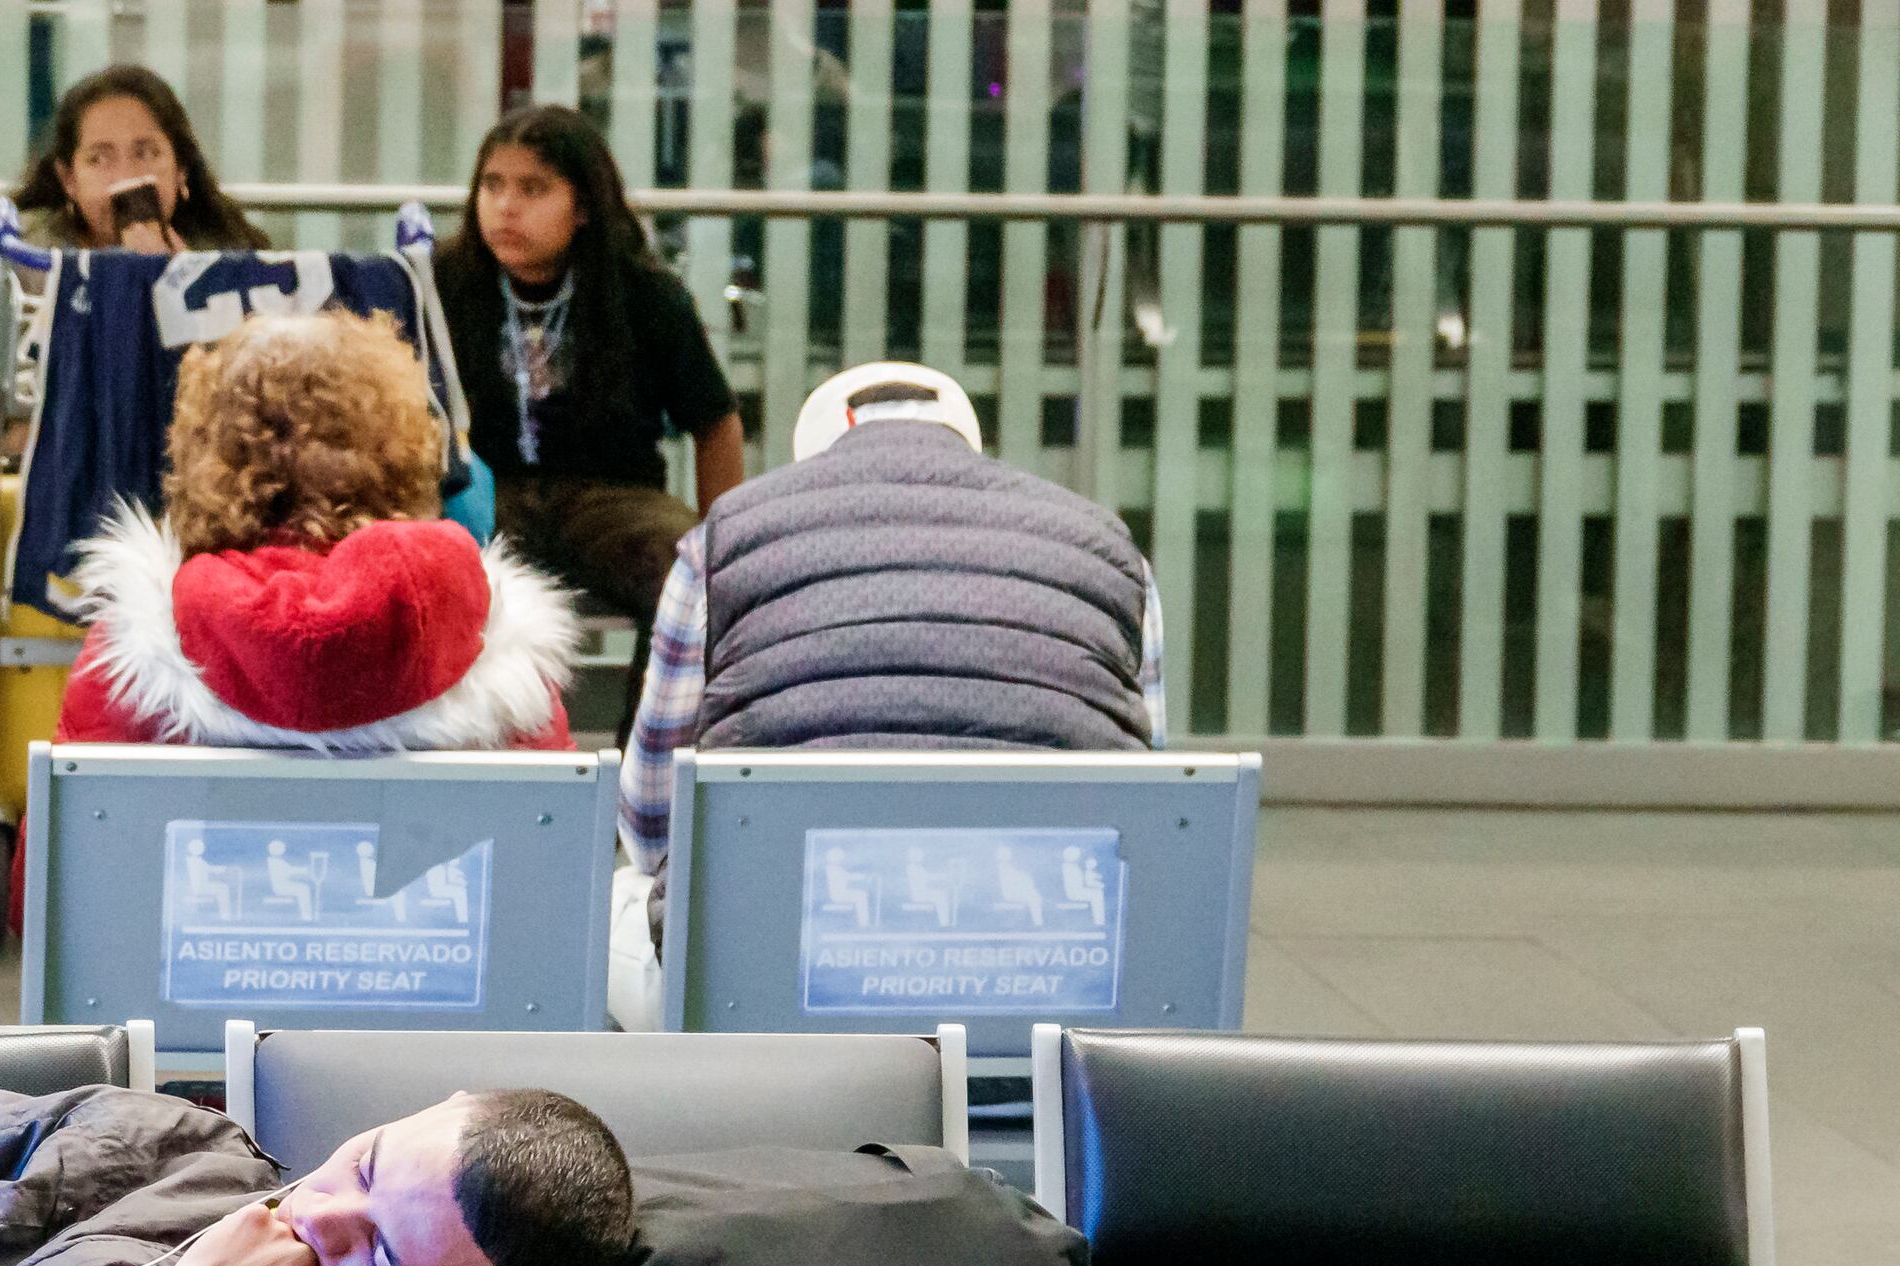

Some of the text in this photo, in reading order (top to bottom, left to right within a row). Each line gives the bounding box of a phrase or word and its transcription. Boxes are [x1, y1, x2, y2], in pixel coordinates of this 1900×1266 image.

[178, 941, 473, 964] ASIENTO RESERVADO
[816, 947, 1110, 968] ASIENTO RESERVADO
[223, 969, 427, 991] PRIORITY SEAT
[861, 975, 1064, 996] PRIORITY SEAT
